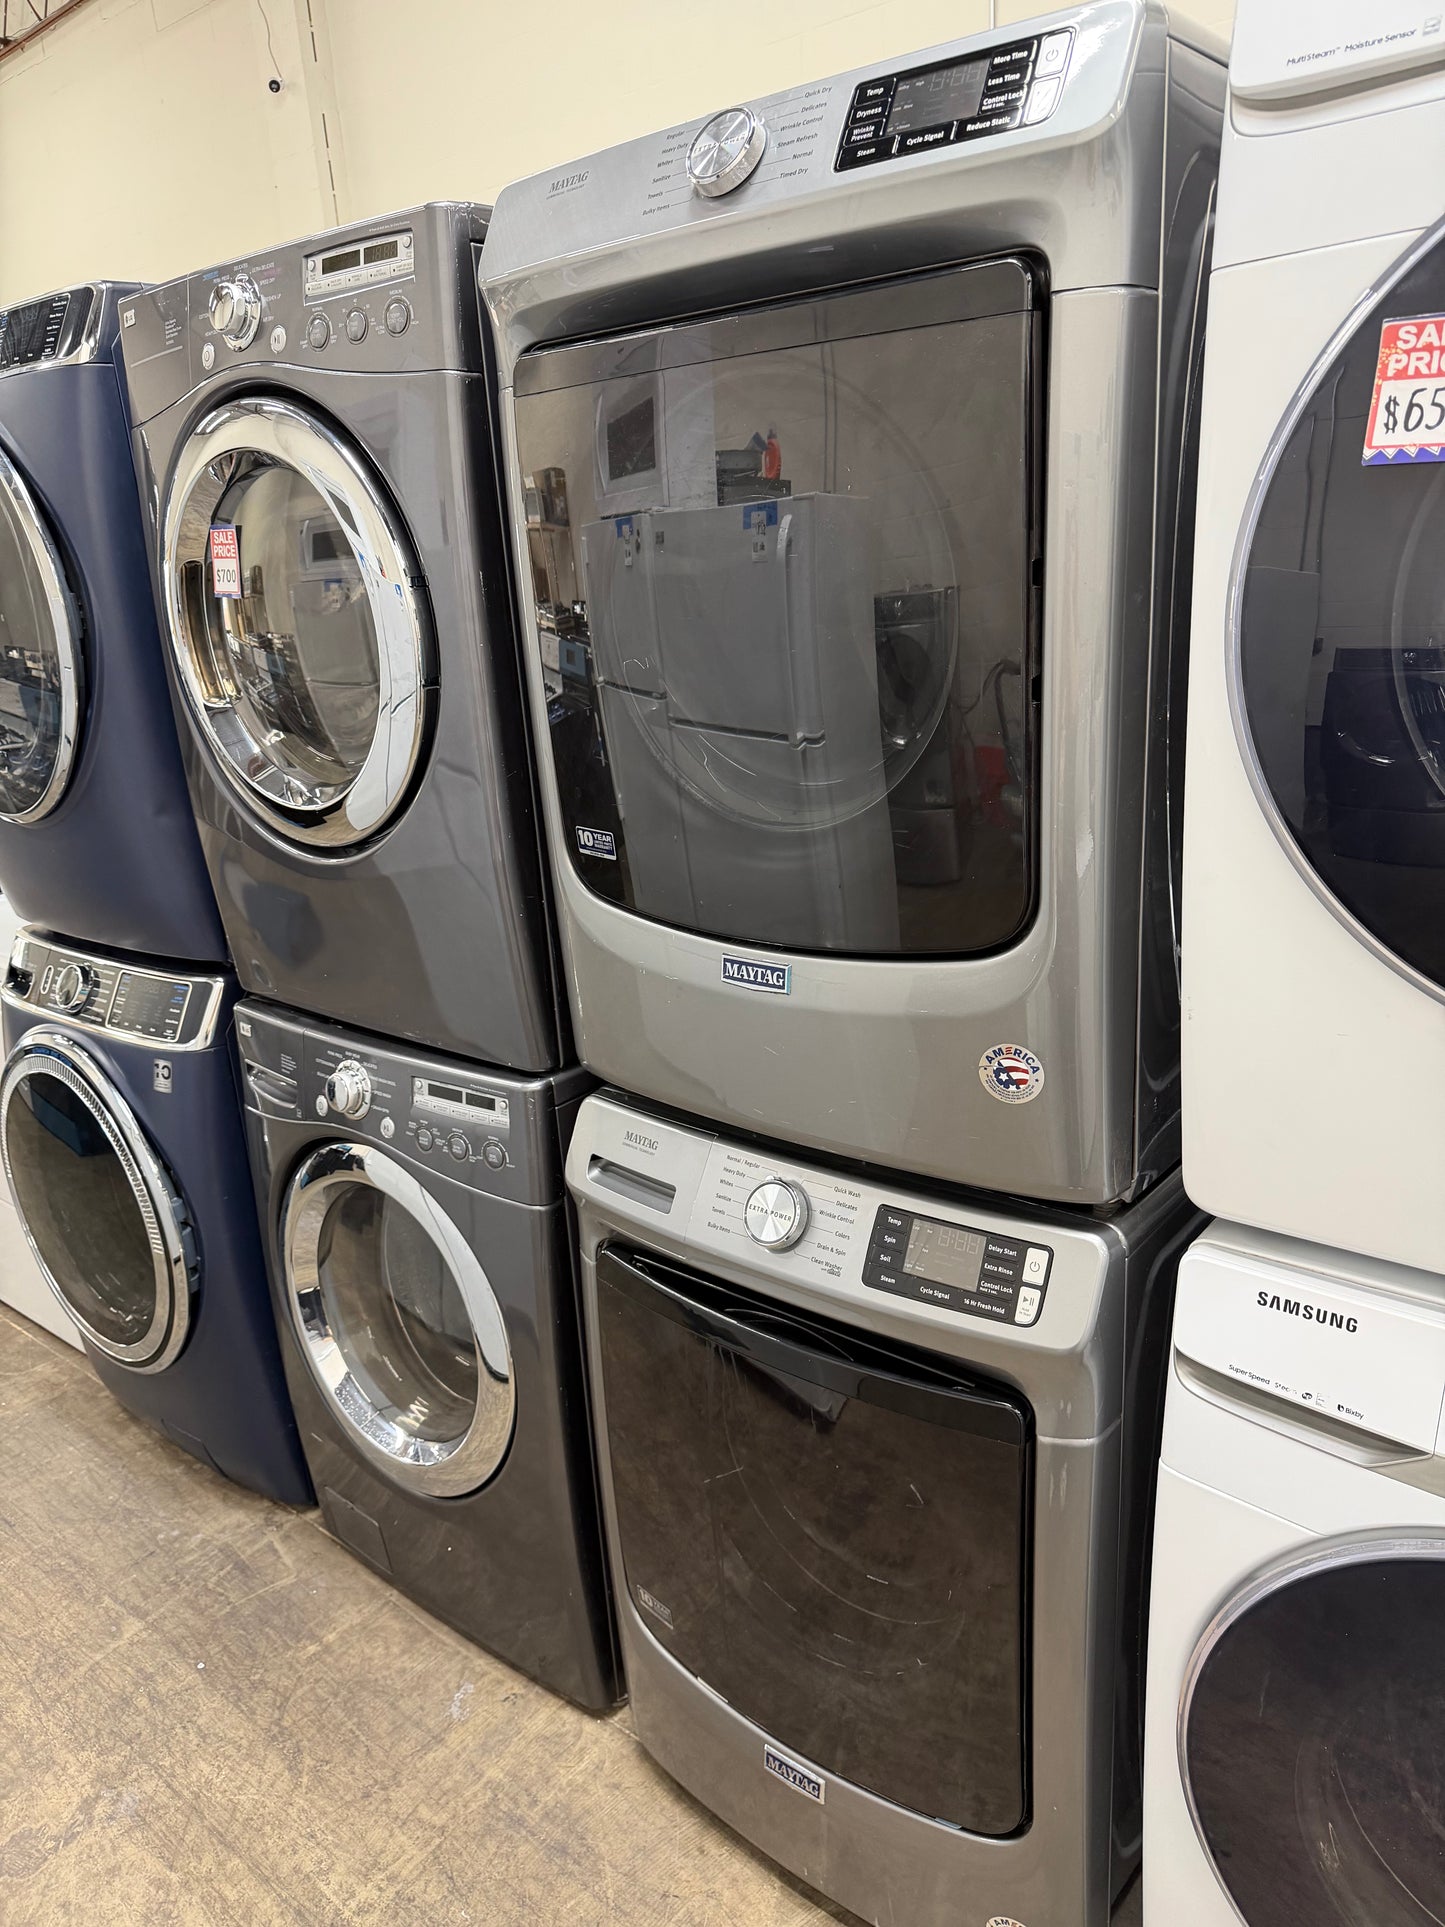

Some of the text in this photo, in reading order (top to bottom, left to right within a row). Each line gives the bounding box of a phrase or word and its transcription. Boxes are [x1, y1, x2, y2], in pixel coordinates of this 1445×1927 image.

[1344, 37, 1383, 52] Moisture
[1385, 29, 1417, 43] Sensor
[993, 51, 1028, 65] More Time
[988, 73, 1021, 86] Less Time
[804, 86, 832, 98] Quick Dry
[867, 87, 884, 97] Temp
[983, 89, 1025, 105] Control Lock
[801, 102, 827, 113] Delicates
[856, 106, 882, 118] Dryness
[780, 115, 824, 132] Wrinkle Control
[853, 125, 875, 135] Wrinkle
[966, 116, 1011, 132] Reduce Static
[776, 132, 818, 149] Steam Refresh
[851, 131, 873, 142] Prevent
[906, 131, 945, 146] Cycle Signal
[661, 142, 688, 155] Heavy Duty
[792, 149, 813, 161] Normal
[856, 148, 876, 157] Steam
[780, 167, 808, 179] Timed Dry
[548, 170, 590, 193] MAYTAG
[1396, 323, 1445, 350] SA
[213, 532, 233, 544] SALE
[213, 545, 236, 557] PRICE
[216, 569, 236, 583] $700
[578, 830, 593, 846] 10
[593, 833, 612, 842] YEAR
[725, 962, 784, 986] MAYTAG
[985, 1046, 1040, 1074] AMERICA
[624, 1130, 659, 1151] MAYTAG
[834, 1186, 861, 1198] Quick Wash
[836, 1200, 858, 1211] Delicates
[749, 1203, 792, 1222] EXTRA POWER
[819, 1209, 855, 1224] Wrinkle Control
[887, 1216, 902, 1226] Temp
[835, 1230, 850, 1240] Colors
[883, 1235, 896, 1244] Spin
[816, 1242, 829, 1251] Drain
[835, 1248, 846, 1257] Spin
[988, 1244, 1017, 1257] Delay Start
[811, 1256, 842, 1272] Clean Washer
[880, 1254, 891, 1263] Soil
[984, 1262, 1013, 1276] Extra Rinse
[880, 1275, 896, 1284] Steam
[920, 1286, 950, 1300] Cycle Signal
[980, 1280, 1013, 1294] Control Lock
[977, 1302, 992, 1310] Fresh
[992, 1306, 1005, 1314] Hold
[1256, 1291, 1359, 1333] SAMSUNG
[1345, 1407, 1364, 1420] Bixby
[768, 1755, 819, 1796] MAYTAG
